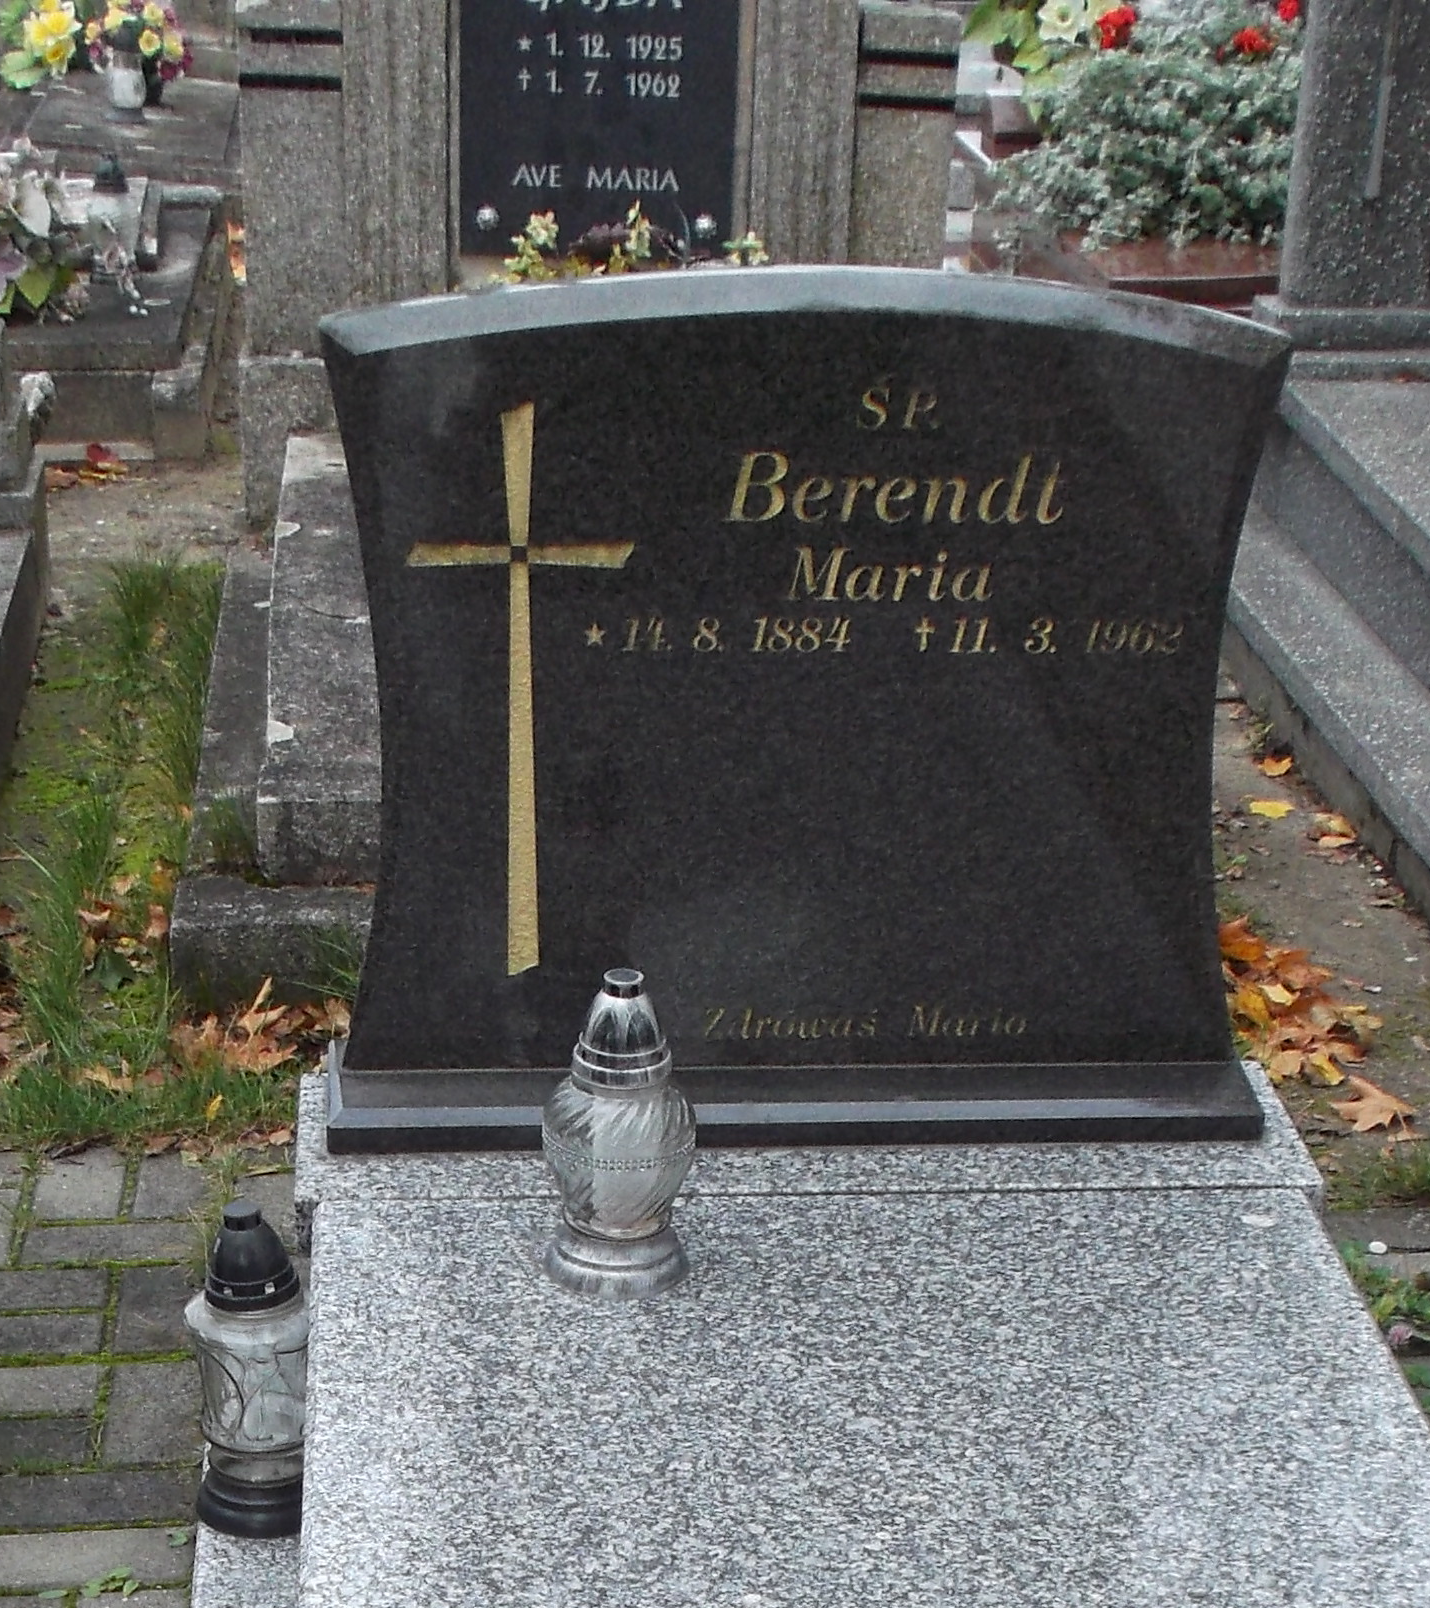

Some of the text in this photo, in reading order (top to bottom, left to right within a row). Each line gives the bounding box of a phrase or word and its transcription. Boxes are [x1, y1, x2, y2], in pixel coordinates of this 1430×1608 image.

[625, 34, 684, 61] 1925
[625, 71, 681, 98] 1962
[512, 163, 681, 193] AVE MARIA
[722, 449, 1066, 526] Berendt
[788, 545, 994, 602] Maria
[749, 614, 852, 654] 1884
